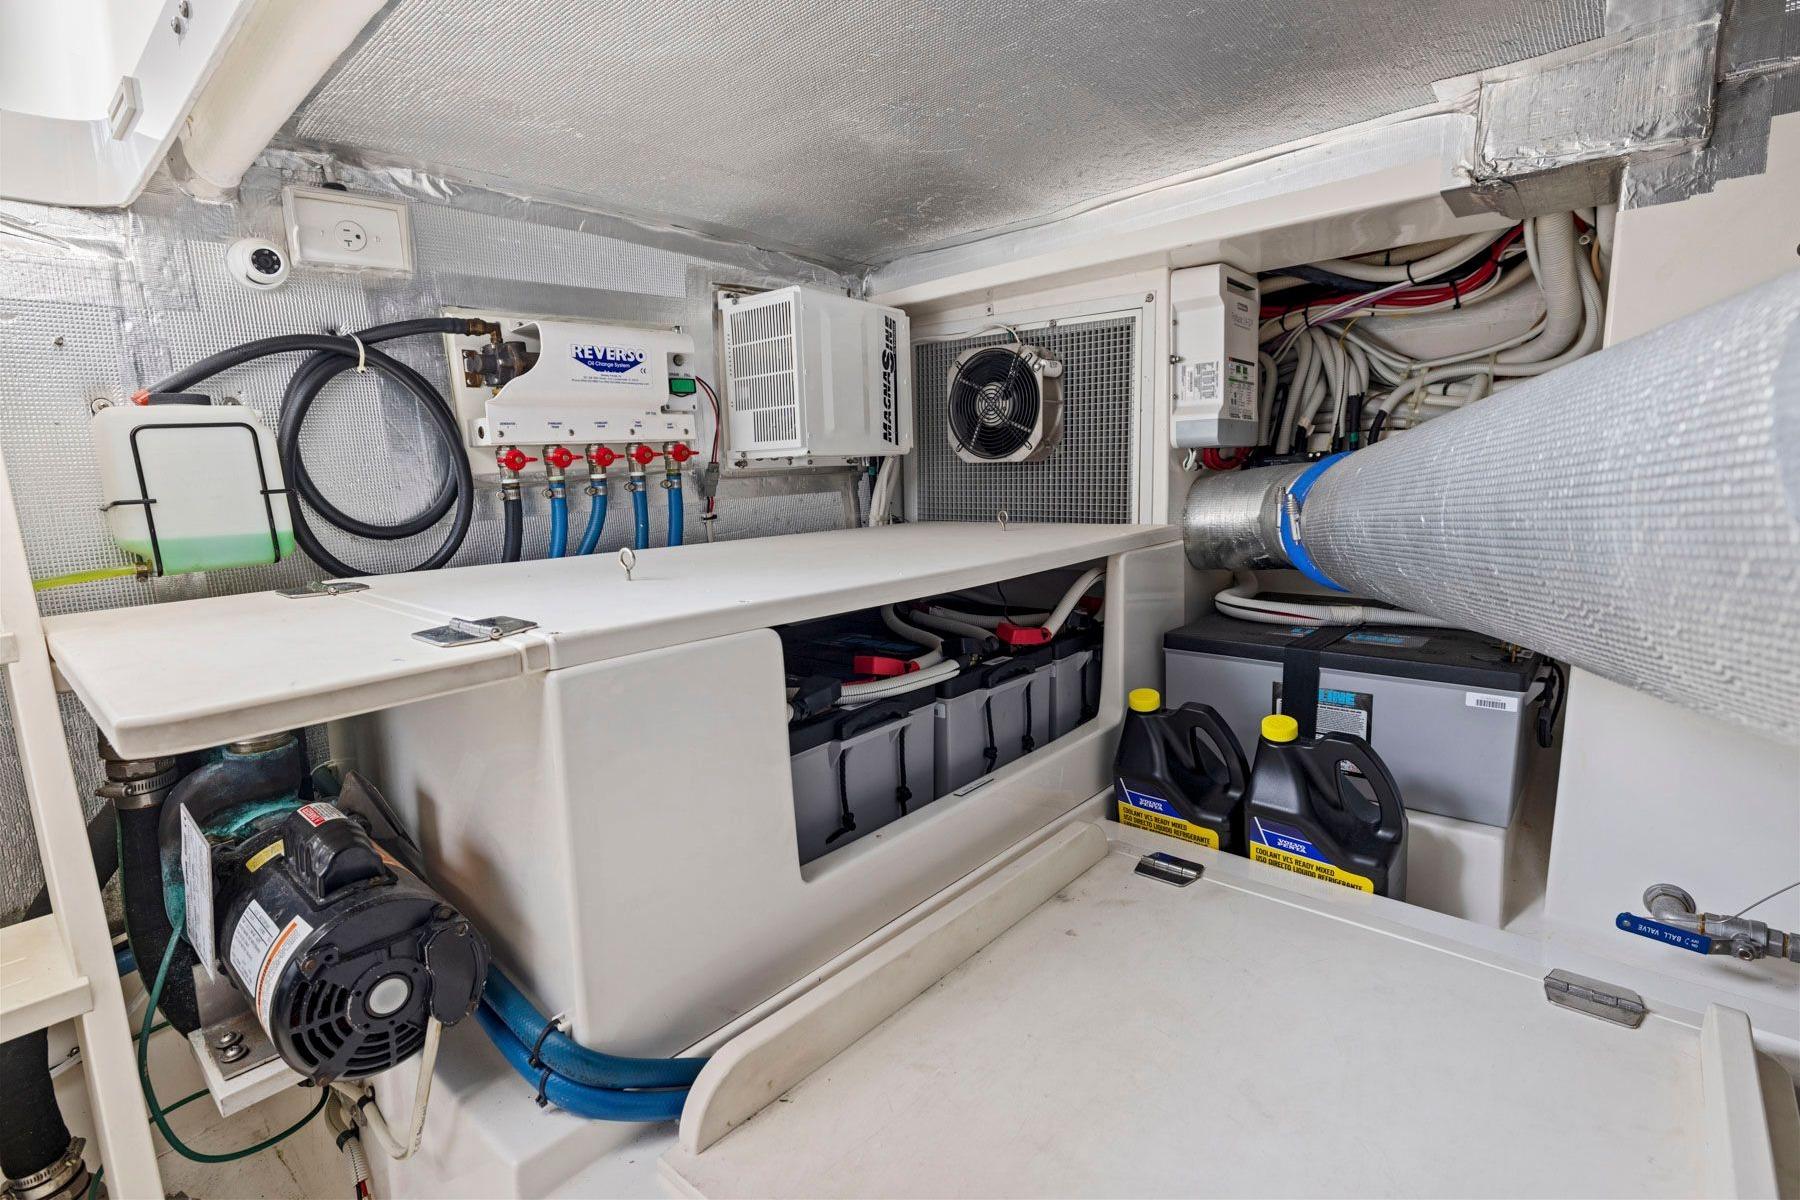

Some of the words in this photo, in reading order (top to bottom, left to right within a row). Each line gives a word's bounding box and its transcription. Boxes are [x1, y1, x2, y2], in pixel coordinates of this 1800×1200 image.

[570, 344, 646, 362] REVERSO
[1123, 807, 1143, 818] COOLANT
[1144, 813, 1153, 821] VCS
[1153, 816, 1170, 826] READY
[1171, 821, 1188, 830] MIXED
[1133, 817, 1153, 828] DIRECTO
[1173, 828, 1210, 844] REFRIGERANTE
[1277, 838, 1306, 850] VOLVO
[1277, 842, 1307, 854] PENTA
[1255, 848, 1281, 860] COOLANT
[1282, 855, 1293, 864] VCS
[1295, 859, 1314, 870] READY
[1315, 865, 1335, 876] MIXED
[1255, 855, 1267, 863] USO
[1268, 858, 1291, 871] DIRECTO
[1638, 924, 1659, 936] VALVE
[1664, 931, 1682, 942] BALL
